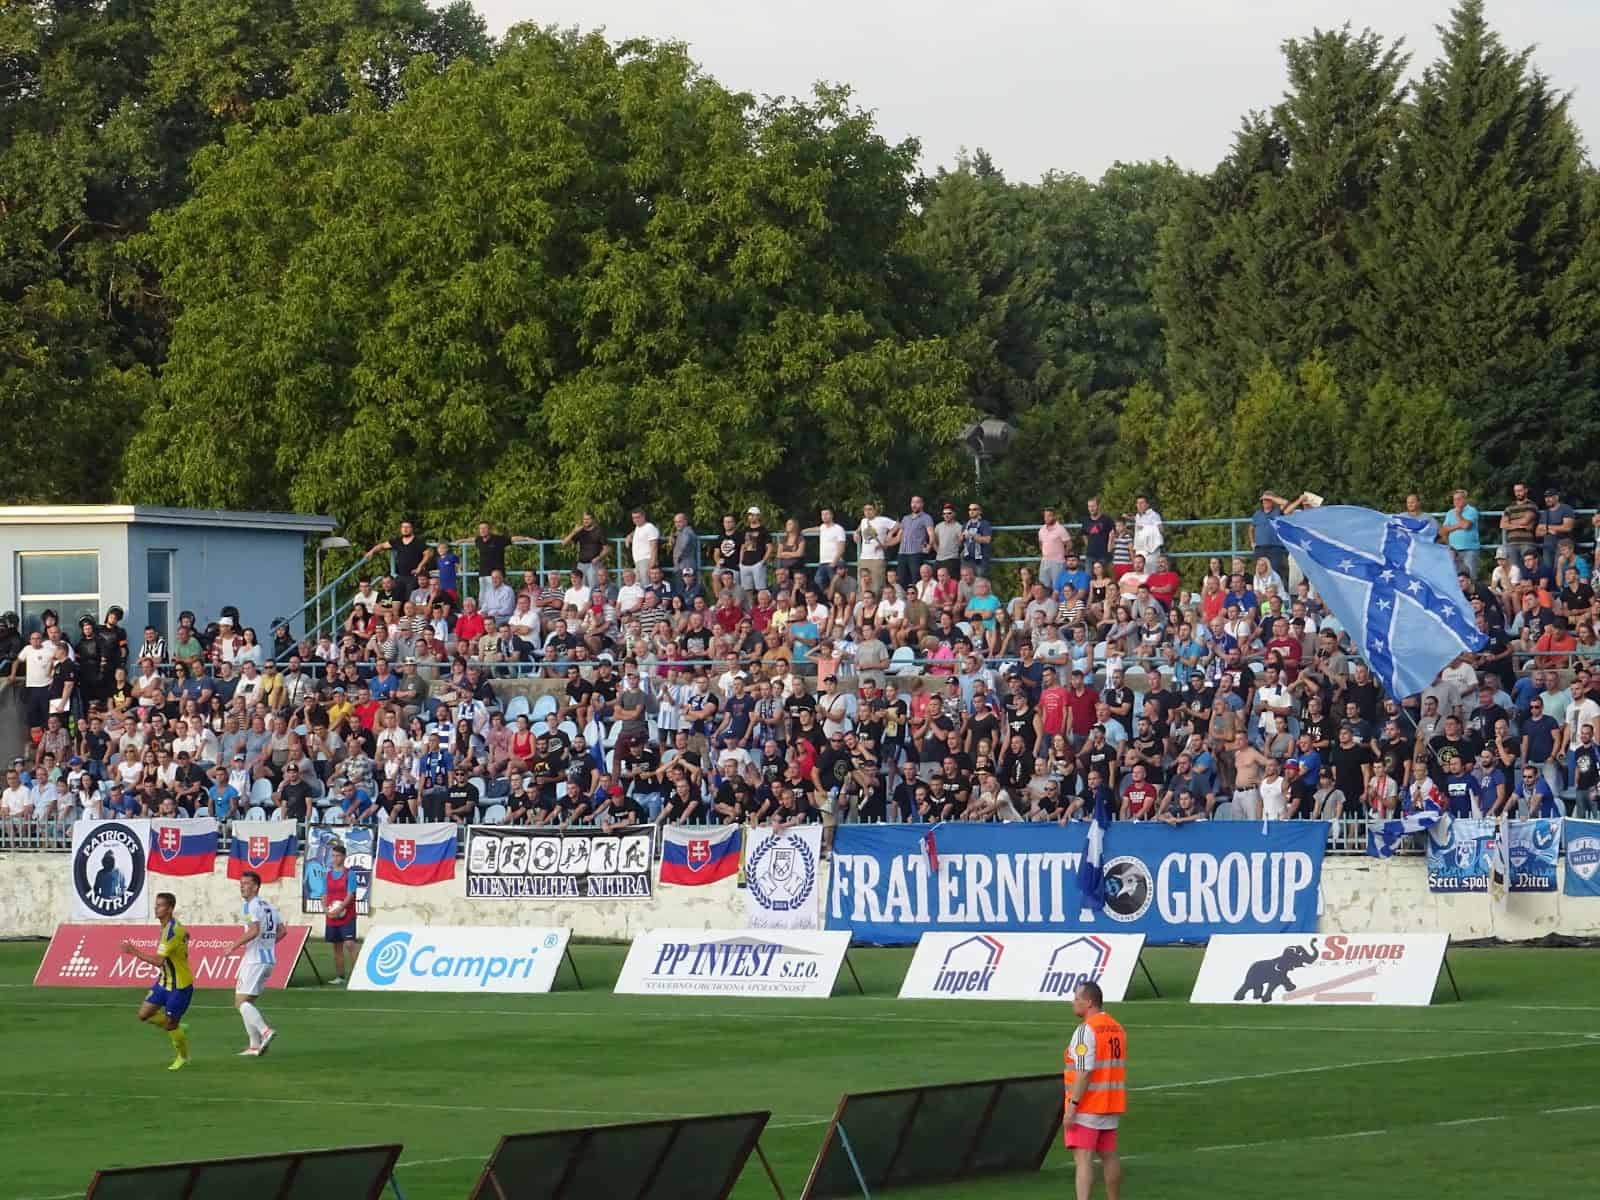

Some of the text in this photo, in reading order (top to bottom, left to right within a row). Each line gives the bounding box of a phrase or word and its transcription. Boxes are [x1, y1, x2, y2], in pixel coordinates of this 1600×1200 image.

[83, 830, 138, 856] PATRIOTS
[469, 875, 650, 897] MENTALITA NITRA
[831, 852, 1096, 923] FRATERNIT
[1156, 852, 1313, 924] GROUP
[86, 888, 134, 911] NITRA
[109, 956, 161, 979] Mes
[409, 945, 538, 987] Campri
[651, 943, 819, 978] PP INVEST s.r.o.
[933, 966, 998, 994] inpek
[1108, 1037, 1121, 1059] 18
